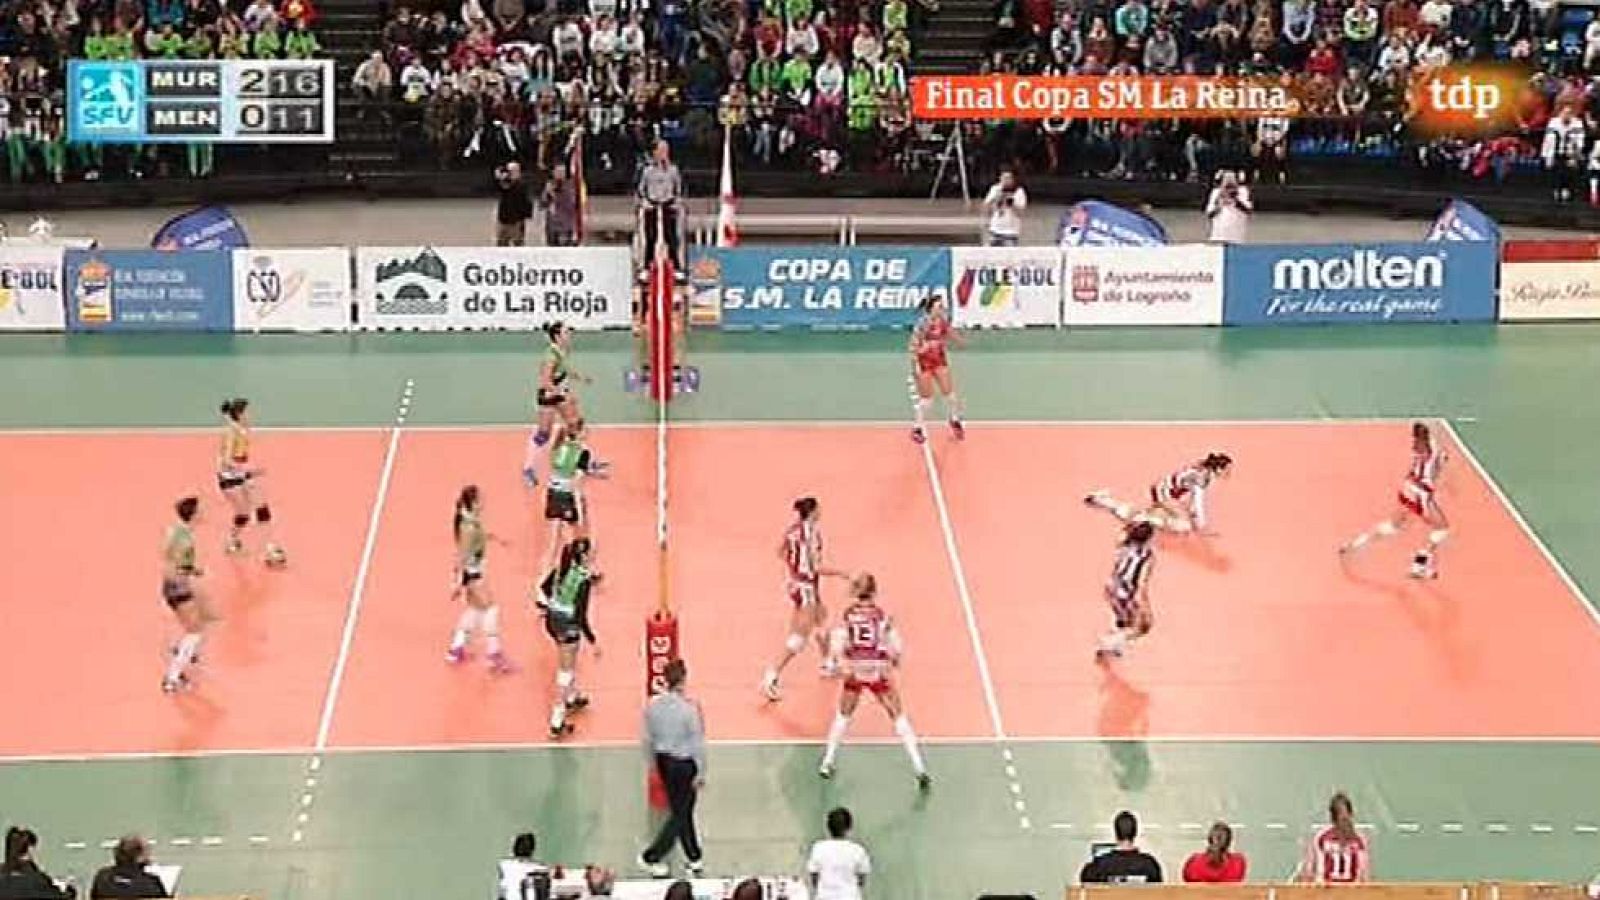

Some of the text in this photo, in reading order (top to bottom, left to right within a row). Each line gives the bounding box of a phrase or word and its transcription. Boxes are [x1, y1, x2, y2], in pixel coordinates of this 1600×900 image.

[463, 262, 584, 286] Gobierno
[768, 258, 907, 281] COPA DE
[1273, 250, 1443, 290] molten
[463, 291, 608, 318] de La Rioja
[724, 285, 951, 310] S.M. LA REINA
